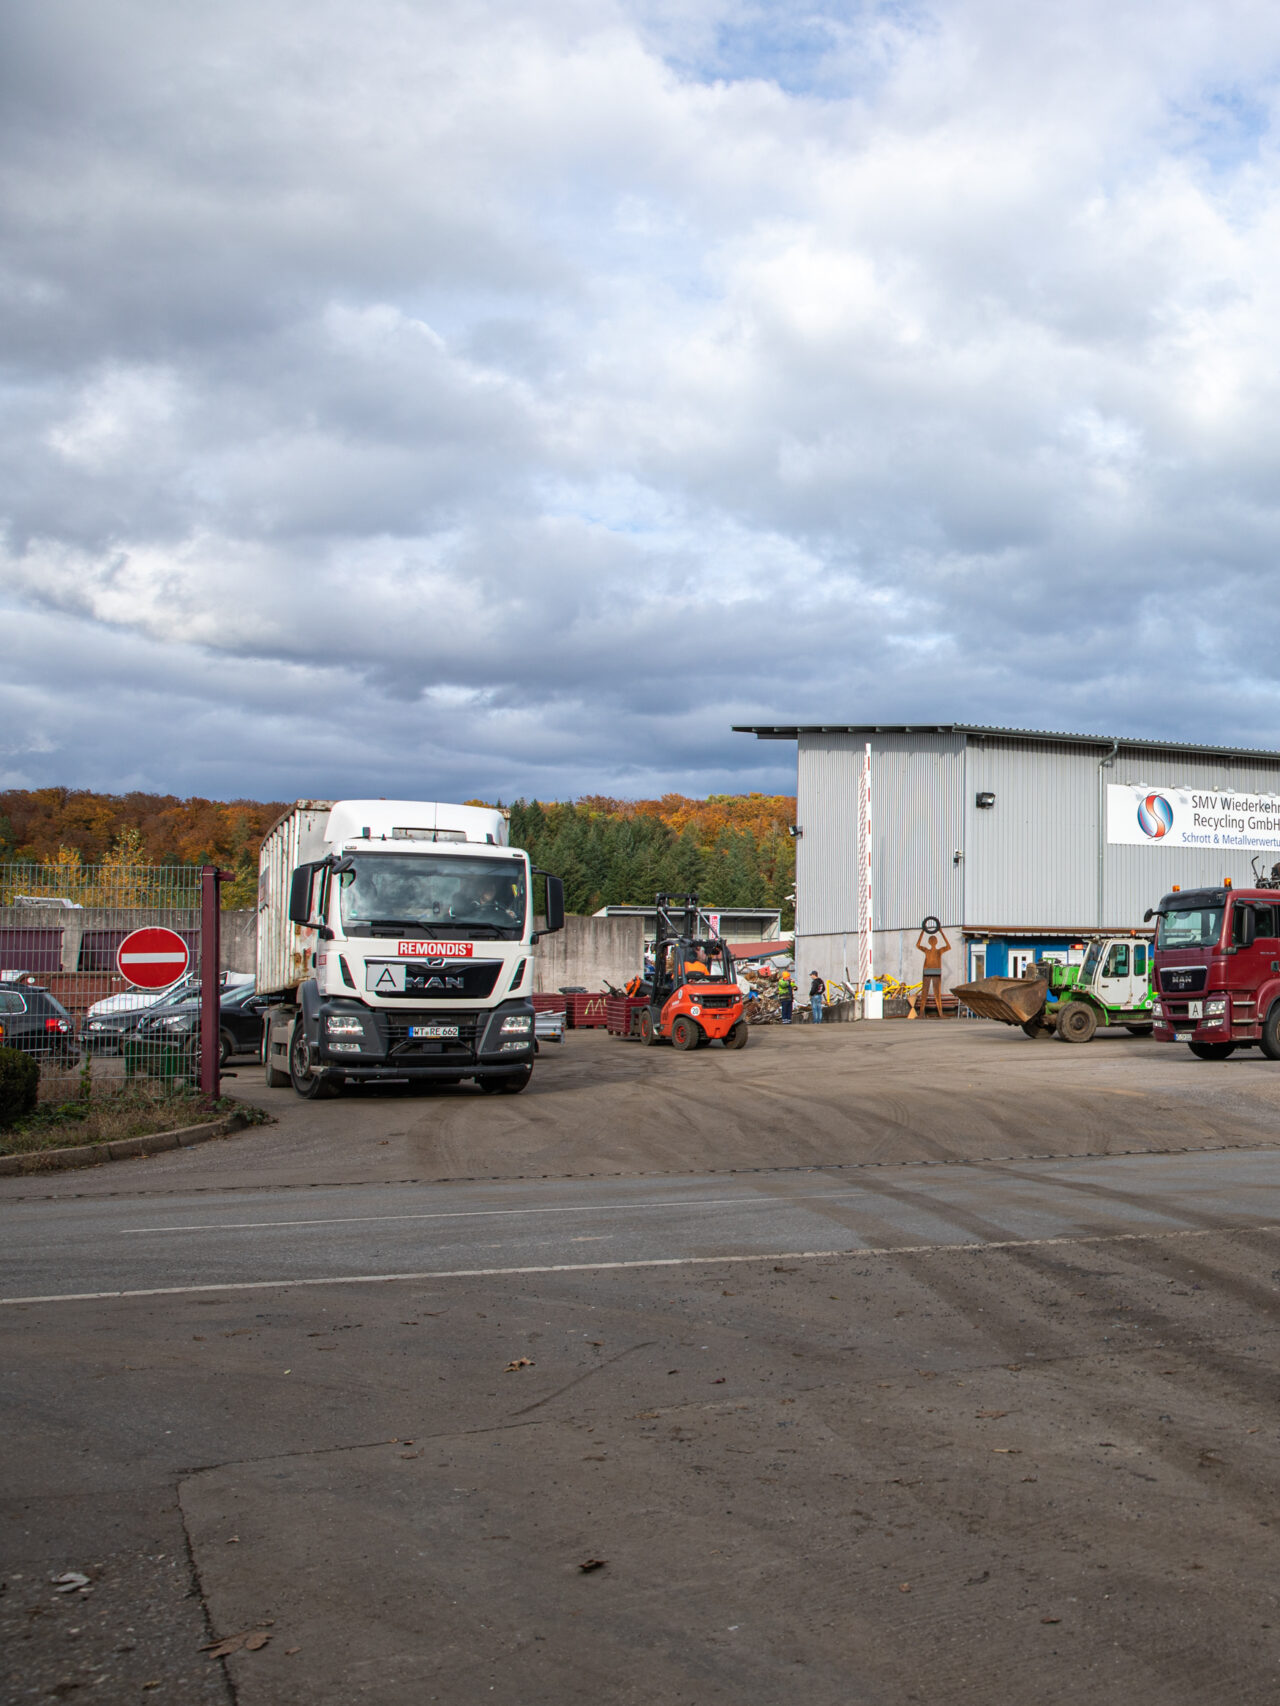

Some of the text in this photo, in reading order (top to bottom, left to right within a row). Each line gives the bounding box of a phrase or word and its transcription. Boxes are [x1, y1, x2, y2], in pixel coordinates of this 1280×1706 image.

[1191, 795, 1218, 809] SMV
[1193, 813, 1280, 832] Recycling GmbH
[1182, 832, 1211, 844] Schrott
[1213, 833, 1219, 844] &
[376, 968, 396, 987] A
[405, 977, 464, 988] MAN
[1192, 1003, 1199, 1016] A
[414, 1027, 458, 1035] WT RE 662
